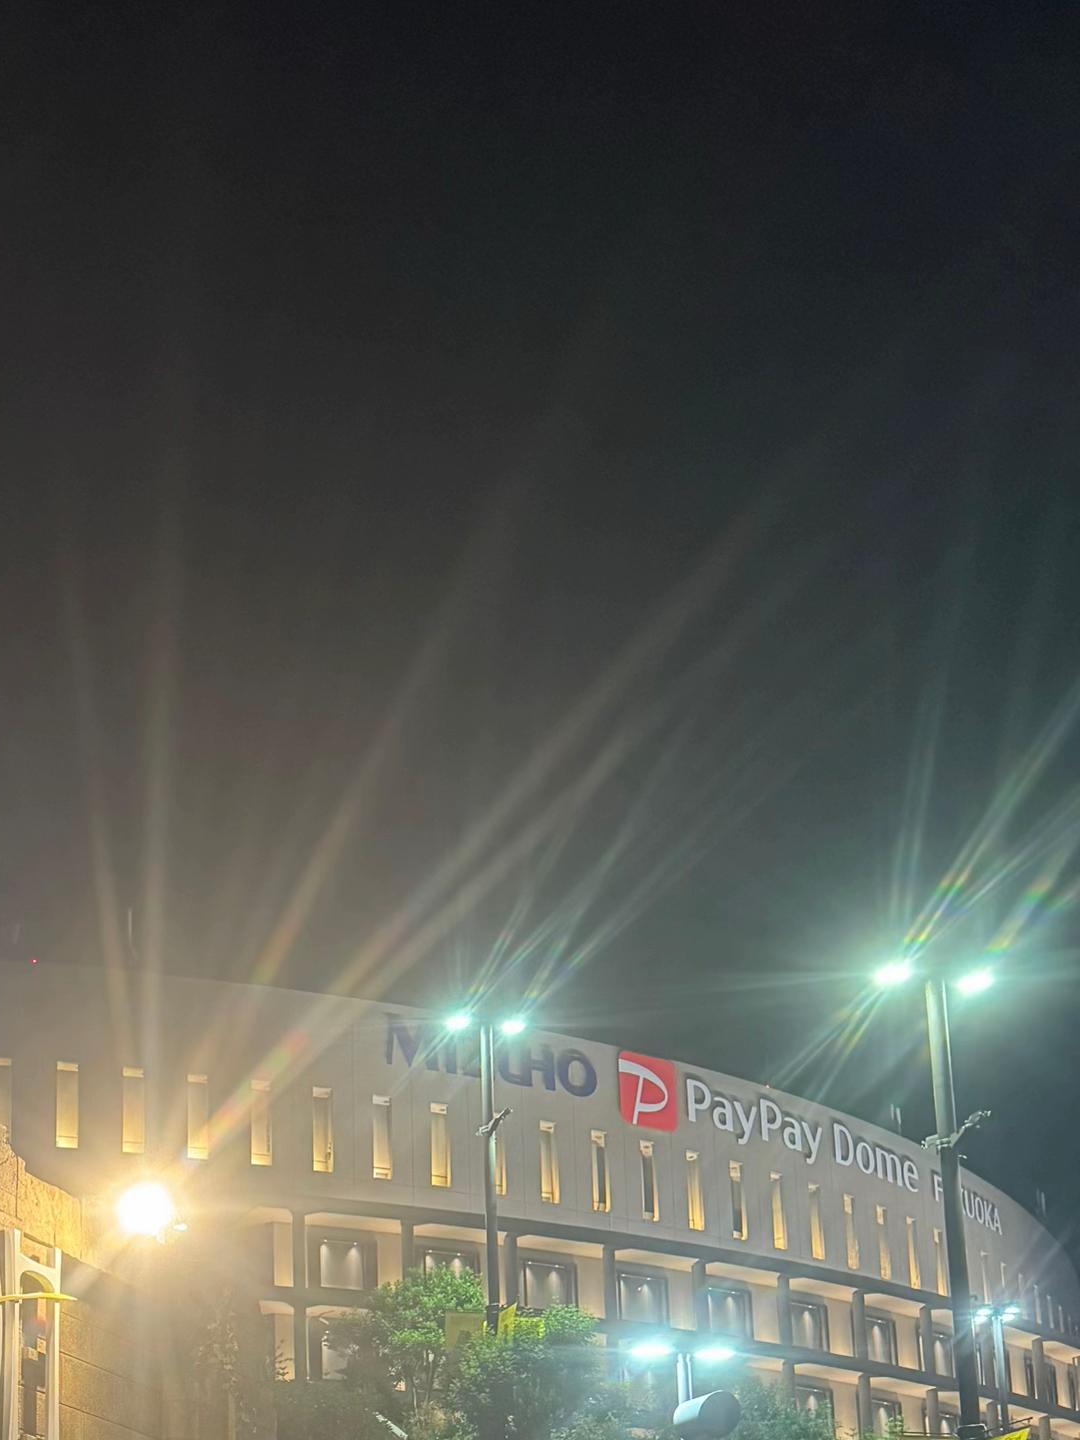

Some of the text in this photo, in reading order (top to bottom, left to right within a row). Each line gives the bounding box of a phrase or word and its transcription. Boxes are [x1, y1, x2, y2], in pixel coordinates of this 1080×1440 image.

[686, 1078, 1003, 1236] PayPay Dome FUOKA
